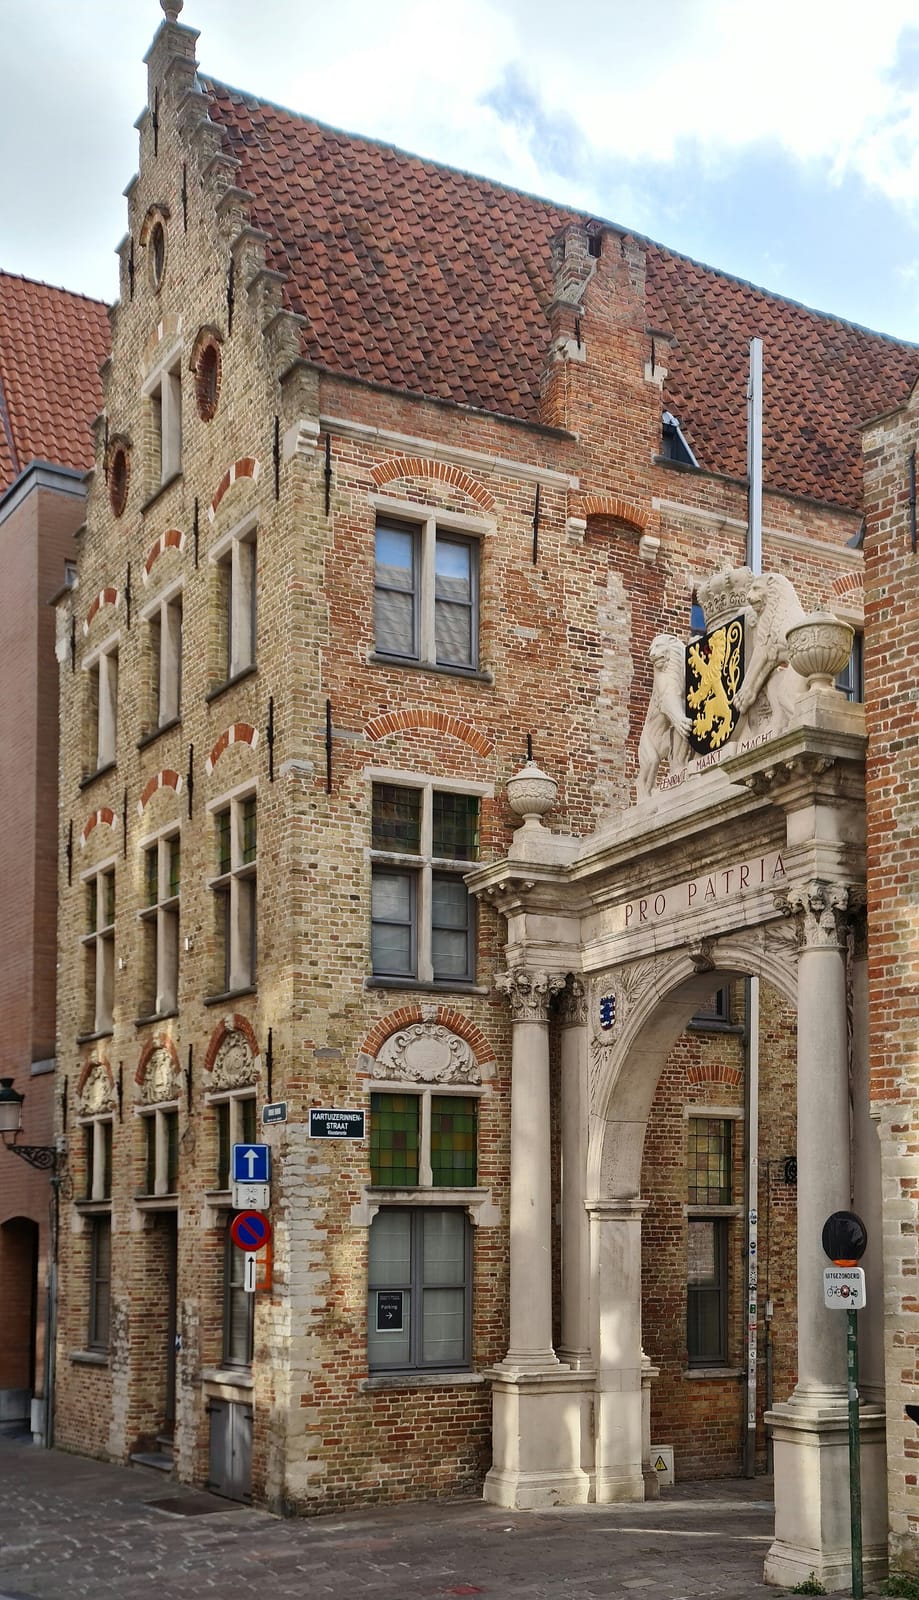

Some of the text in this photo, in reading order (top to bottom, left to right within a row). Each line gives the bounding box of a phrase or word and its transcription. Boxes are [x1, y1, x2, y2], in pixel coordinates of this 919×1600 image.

[696, 749, 722, 772] MAAKT
[741, 730, 773, 752] MACHT
[624, 853, 787, 926] PRO PATRIA
[326, 1122, 349, 1130] STRAAT
[825, 1272, 860, 1280] UITGEZONDERD
